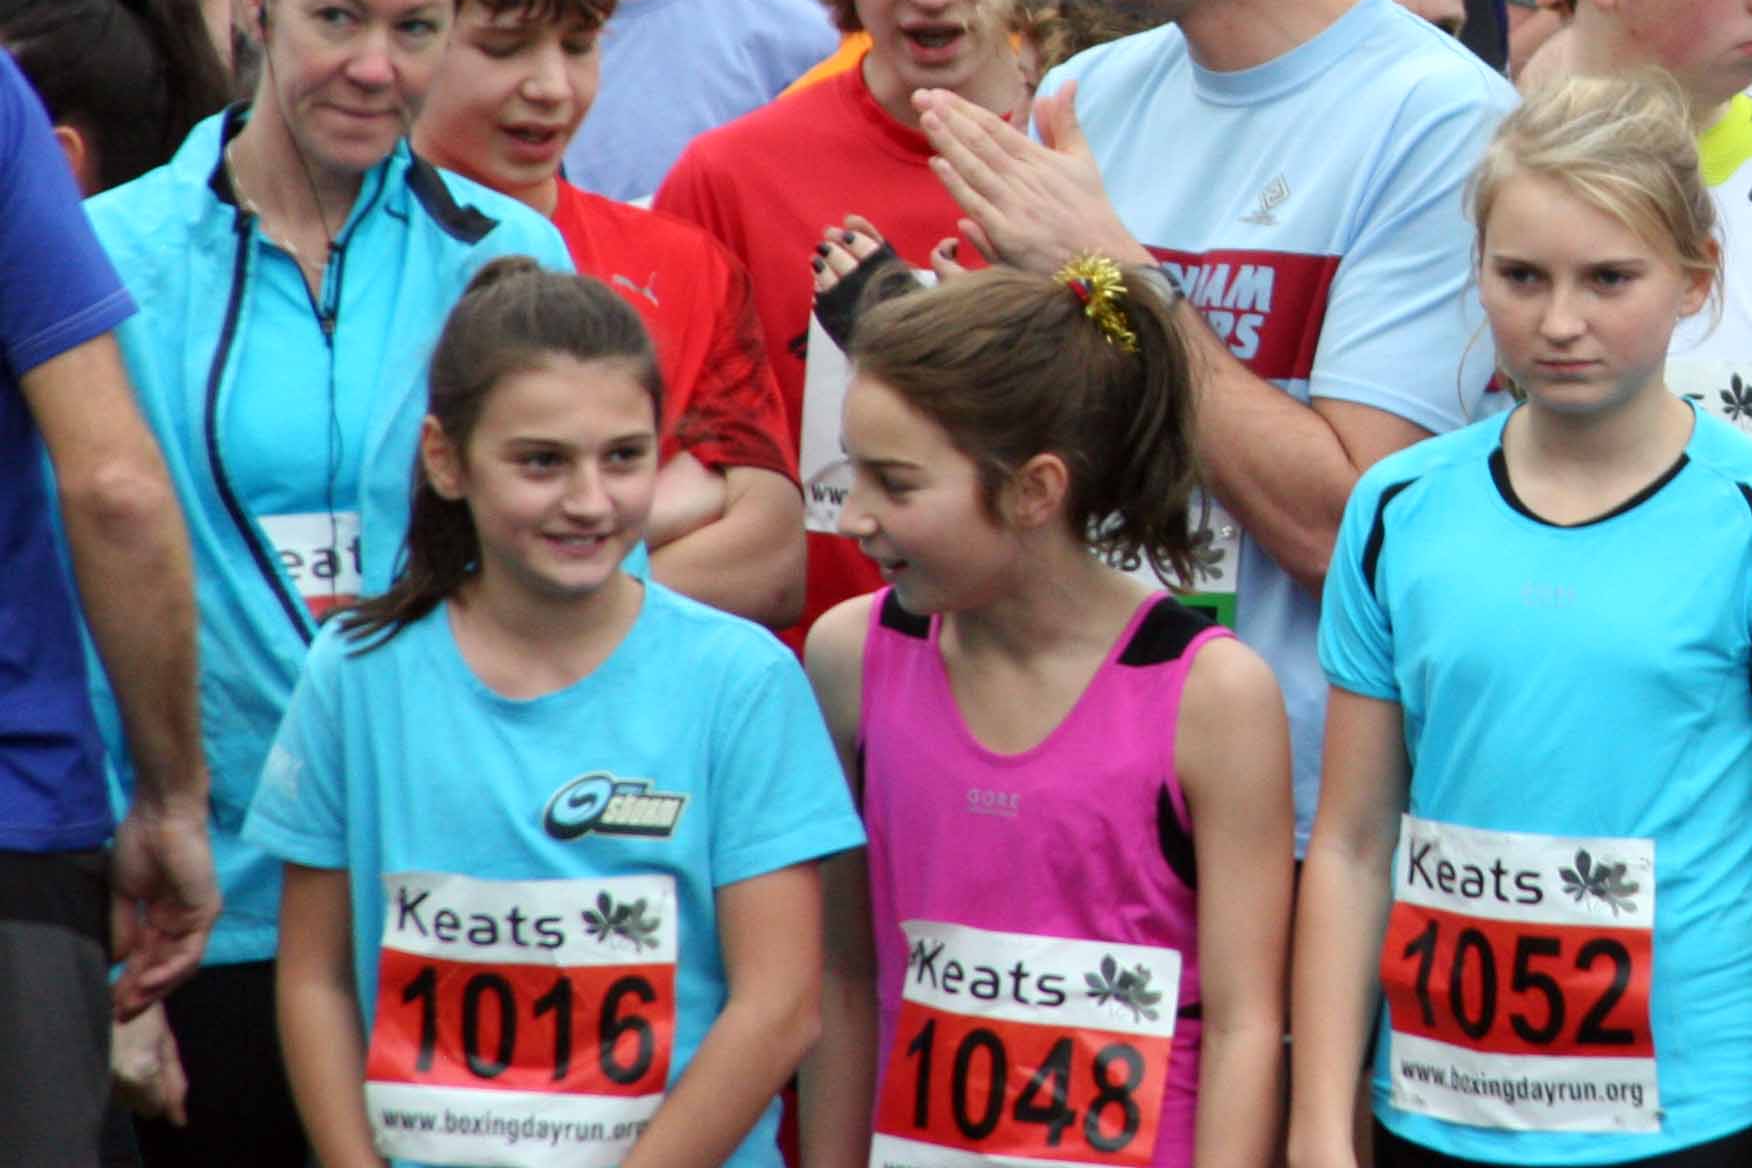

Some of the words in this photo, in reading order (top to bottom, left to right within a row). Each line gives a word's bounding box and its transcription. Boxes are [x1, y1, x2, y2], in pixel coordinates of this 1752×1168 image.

[1407, 839, 1544, 904] Keats
[397, 887, 566, 950] Keats
[911, 939, 1067, 1007] Keats
[1403, 920, 1636, 1046] 1052
[403, 966, 657, 1086] 1016
[906, 1018, 1146, 1153] 1048
[1401, 1056, 1644, 1107] www.boxingdayrun.org
